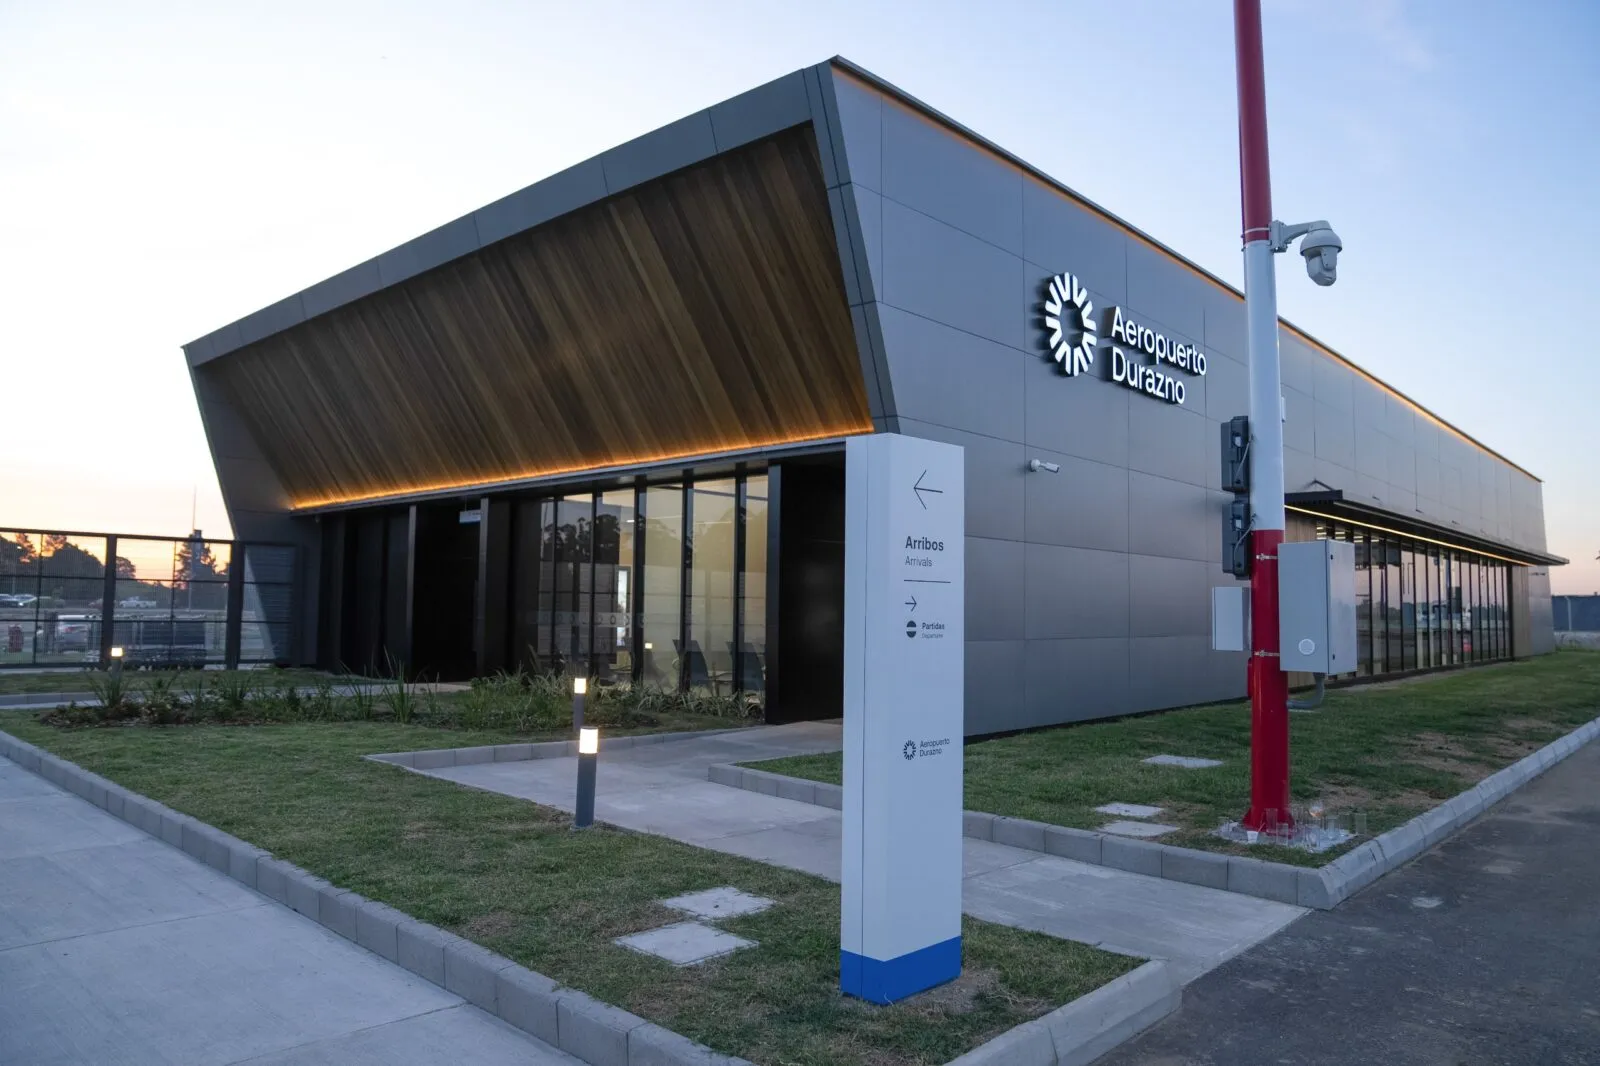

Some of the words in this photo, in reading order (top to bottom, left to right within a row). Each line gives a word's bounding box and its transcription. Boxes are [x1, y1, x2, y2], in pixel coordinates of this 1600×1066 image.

[1111, 306, 1207, 376] Aeropuerto
[1112, 346, 1186, 404] Durazno
[905, 535, 944, 551] Arribos
[905, 555, 933, 567] Arrivals
[921, 622, 945, 630] Partidas
[919, 738, 950, 749] Aeropuerto
[919, 747, 943, 757] Durazno
